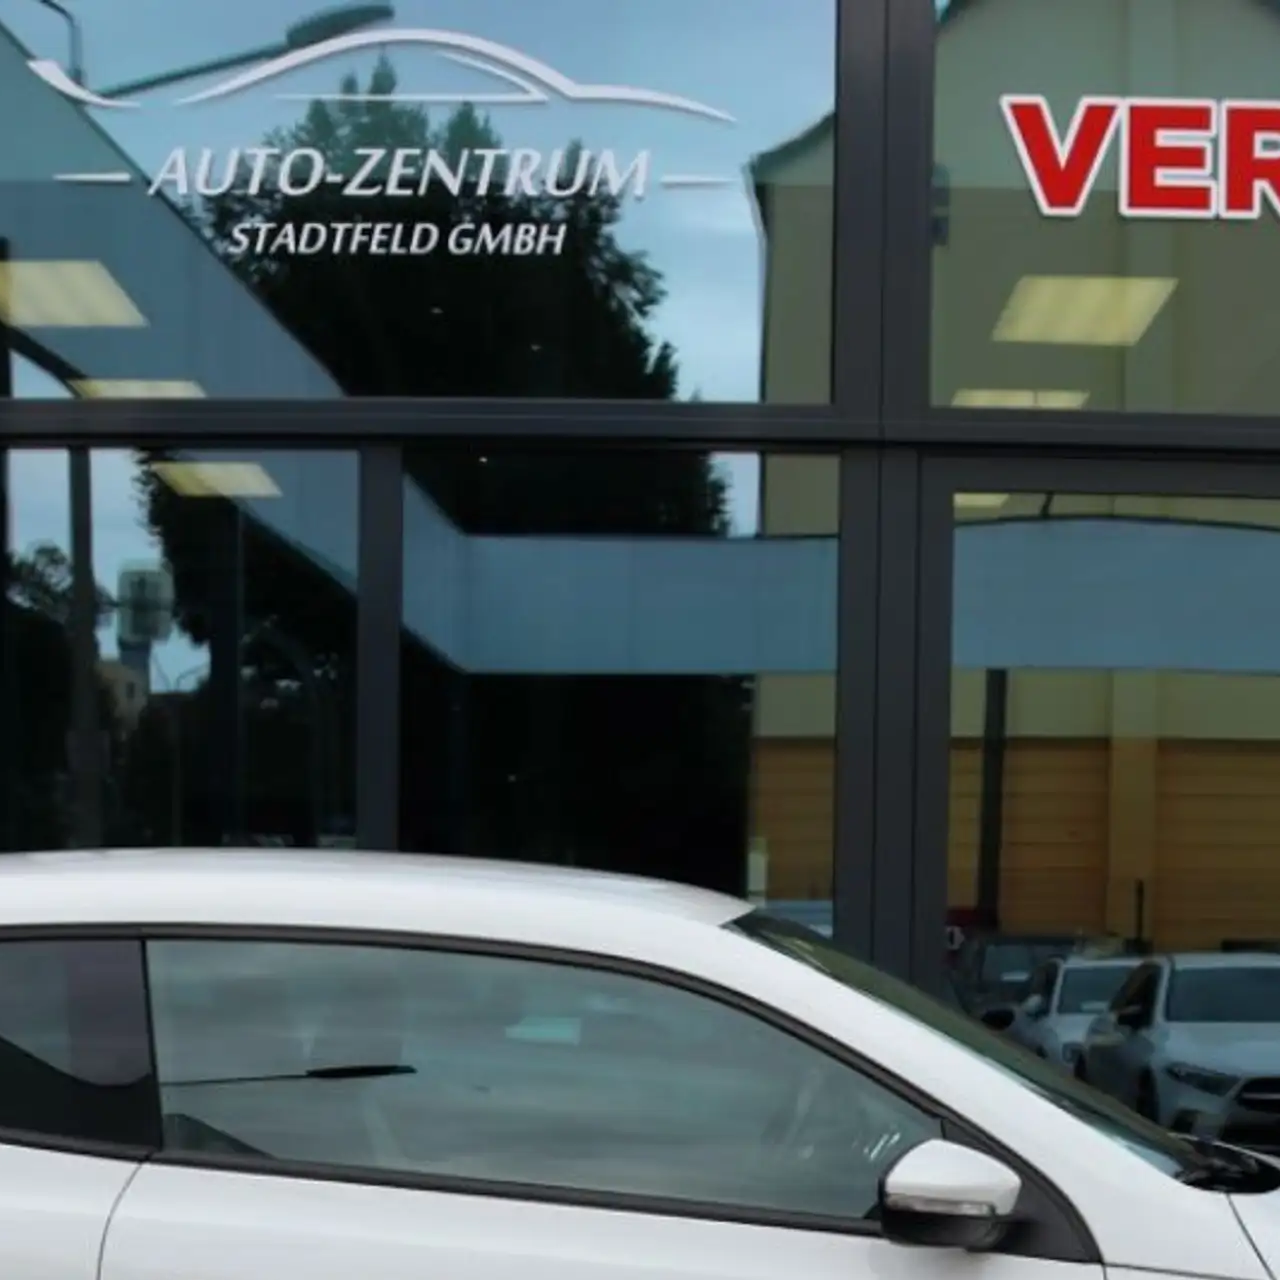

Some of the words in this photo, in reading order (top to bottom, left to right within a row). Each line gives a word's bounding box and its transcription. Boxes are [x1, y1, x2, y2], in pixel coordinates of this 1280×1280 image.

[144, 140, 655, 205] AUTO-ZENTRUM
[220, 216, 438, 253] STADTFELD
[449, 215, 566, 254] GMBH
